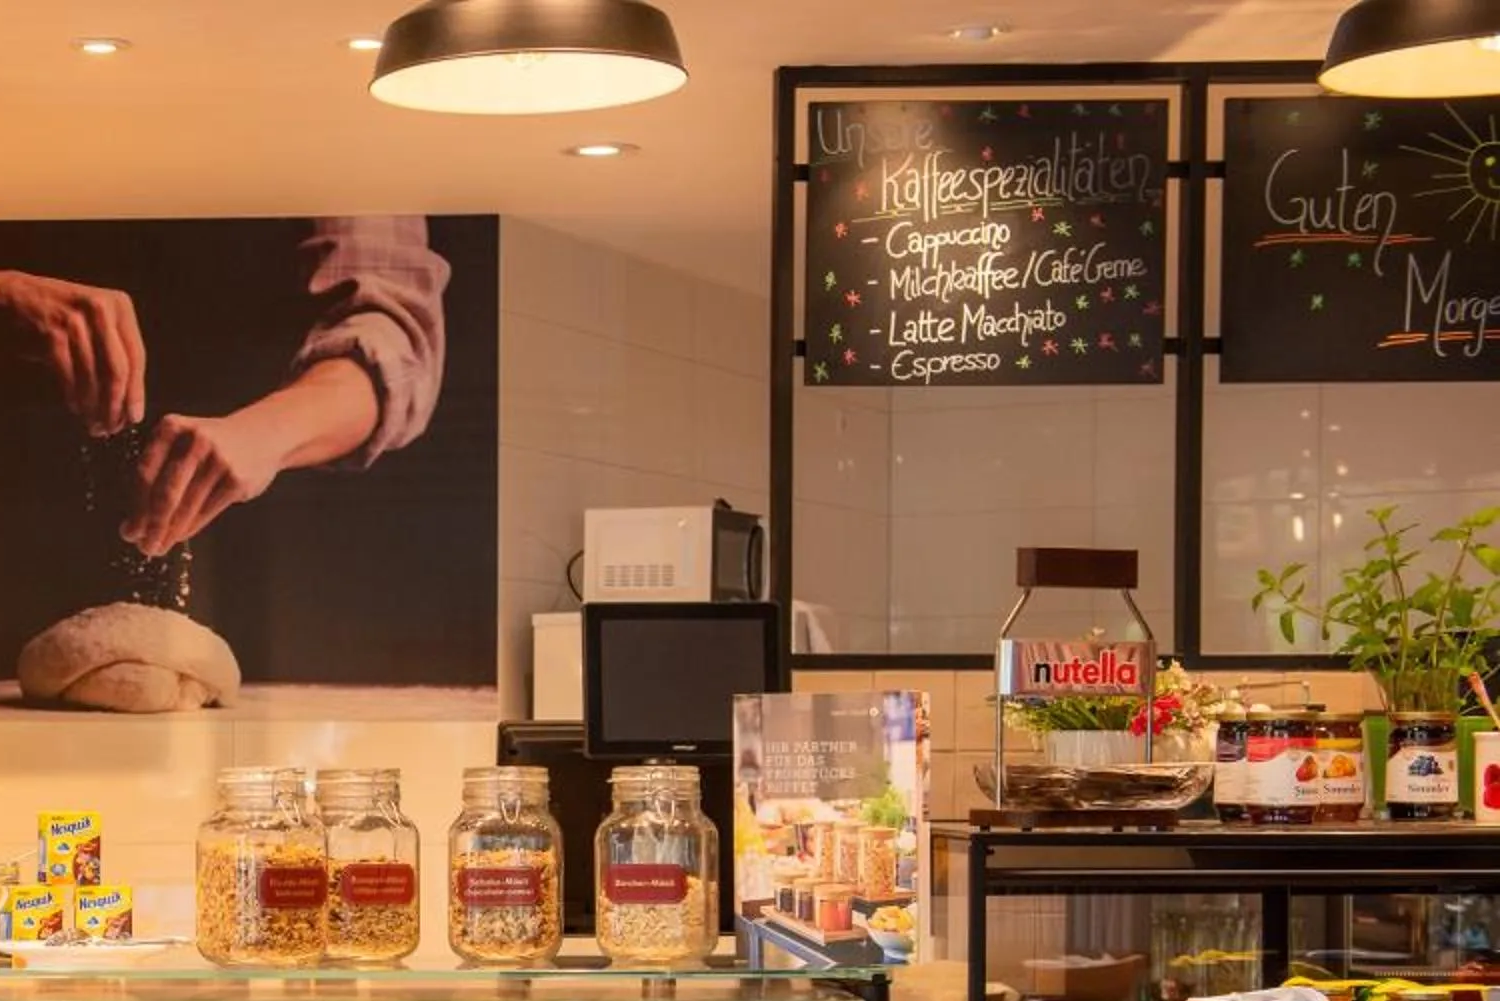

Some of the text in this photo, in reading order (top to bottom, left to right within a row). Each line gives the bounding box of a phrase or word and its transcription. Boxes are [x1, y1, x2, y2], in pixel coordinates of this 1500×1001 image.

[1264, 148, 1398, 277] Guten
[886, 221, 1011, 269] Cappuccino
[1404, 250, 1500, 357] Morge
[888, 299, 1067, 347] Latte Macchiato
[891, 349, 1001, 384] Espresso
[1033, 649, 1137, 685] nutella
[51, 816, 92, 836] Nesquik
[15, 892, 53, 910] Nesquik
[79, 892, 121, 910] Nesquik
